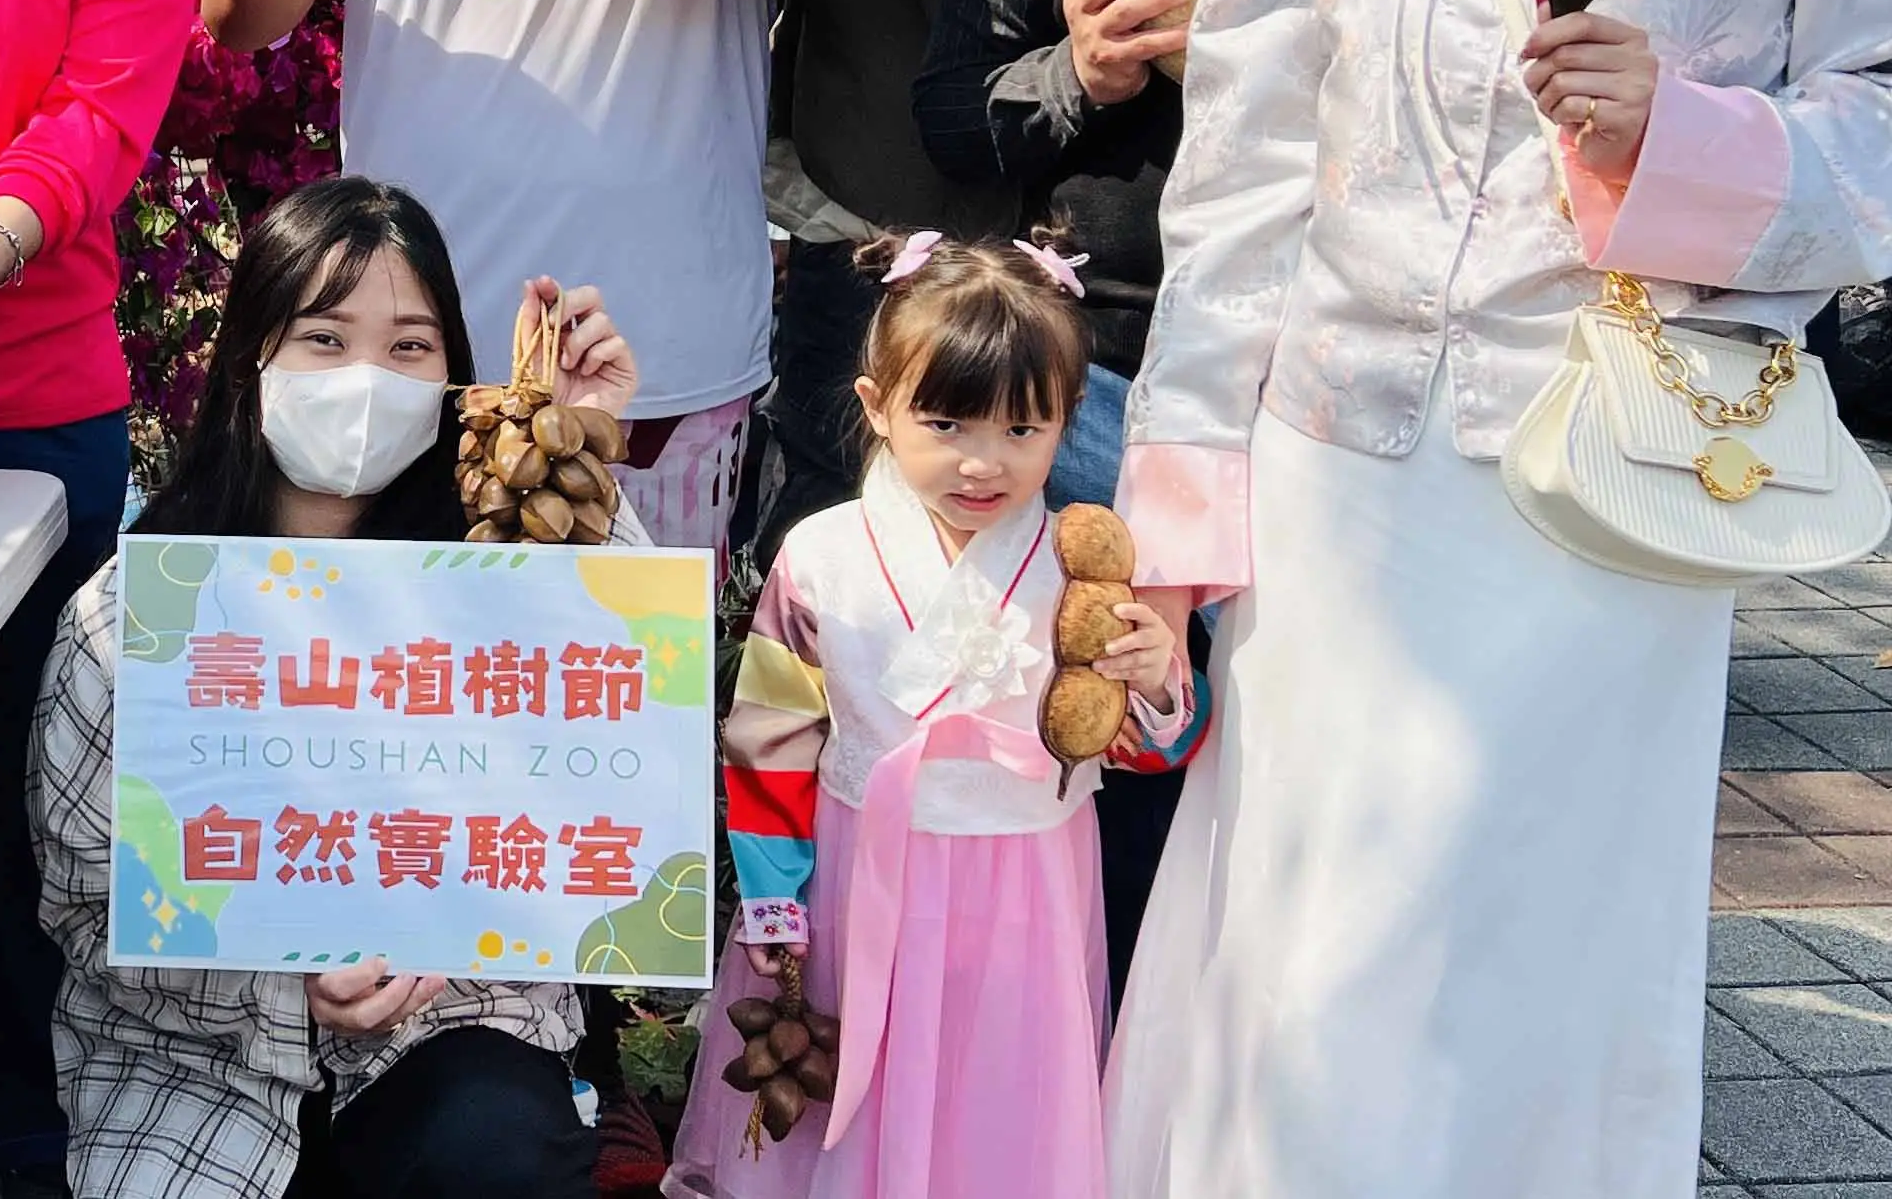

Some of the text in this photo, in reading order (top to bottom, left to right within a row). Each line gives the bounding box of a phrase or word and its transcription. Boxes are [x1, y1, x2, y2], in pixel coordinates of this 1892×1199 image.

[185, 631, 645, 722] 壽山植樹節
[189, 735, 643, 780] SHOUSHAN ZOO
[182, 803, 644, 897] 自然實驗室
